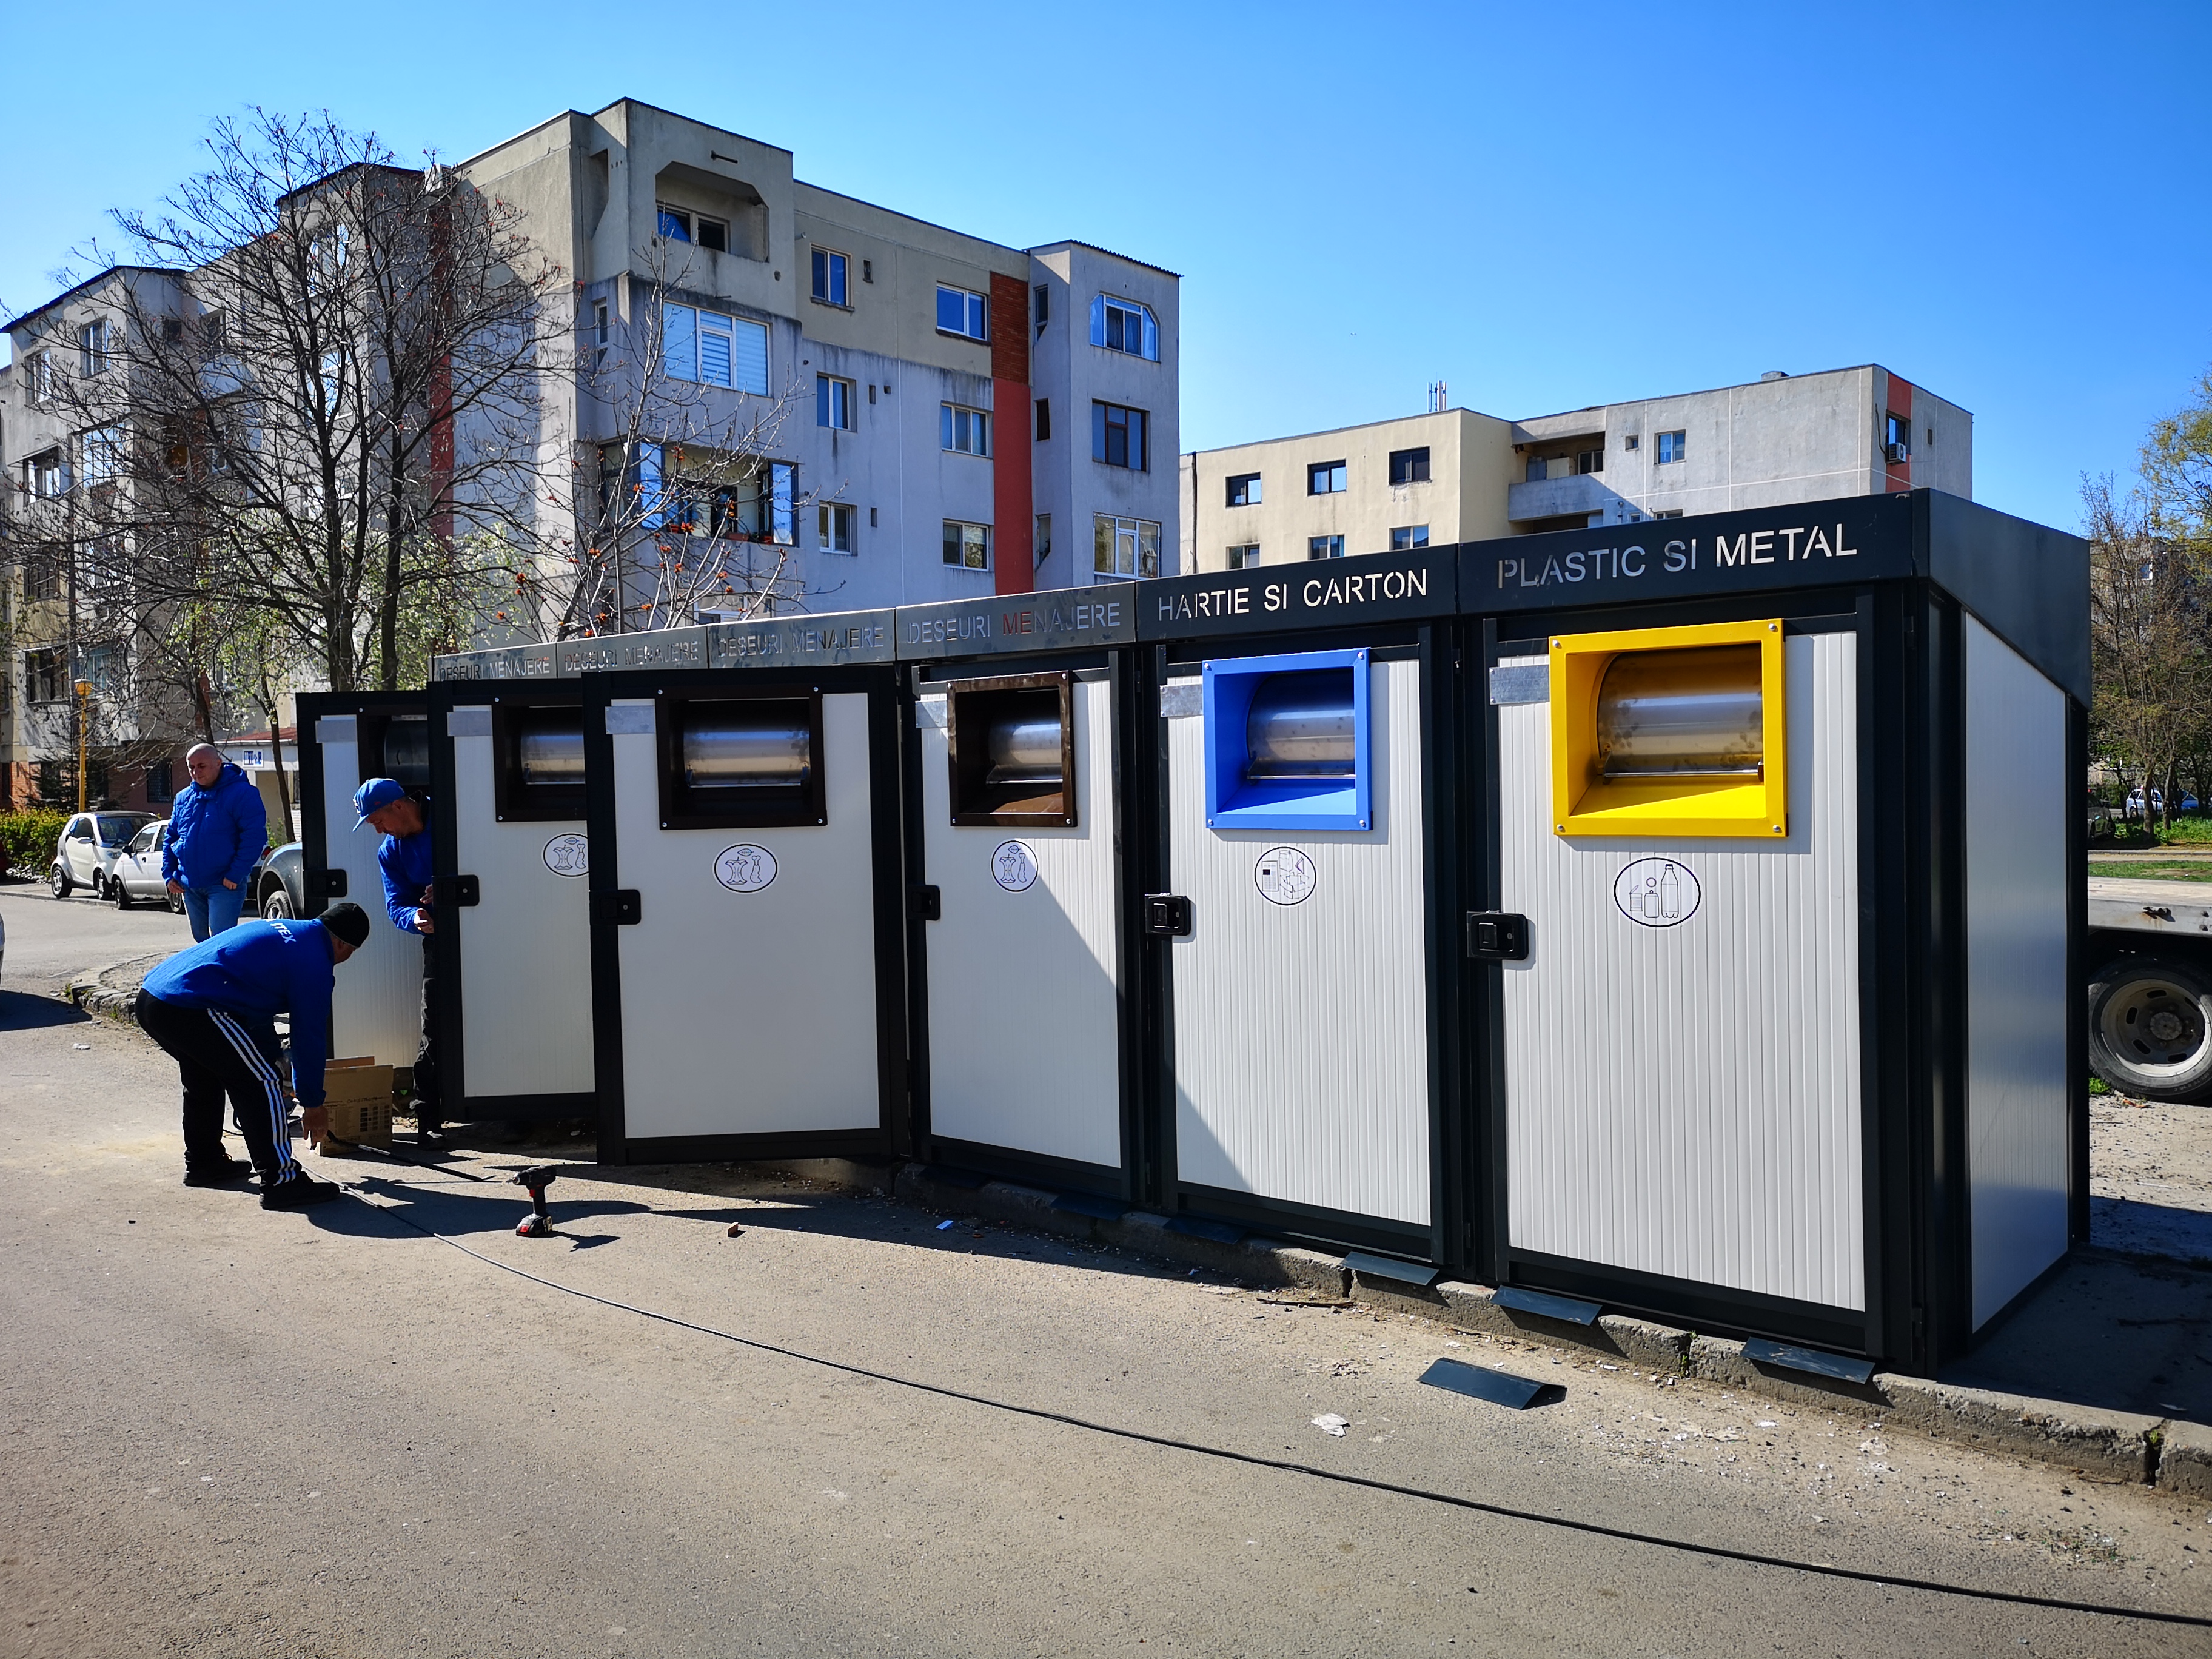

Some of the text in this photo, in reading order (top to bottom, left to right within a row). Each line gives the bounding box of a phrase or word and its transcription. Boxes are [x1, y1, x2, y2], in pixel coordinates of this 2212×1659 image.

[1498, 523, 1857, 589] PLASTIC SI METAL
[1158, 568, 1427, 622] HARTIE SI CARTON
[907, 602, 1121, 644] DESEURI MENAJERE
[564, 640, 699, 672] DESEURI MENAJERE
[718, 626, 884, 657] DESEURI MENAJERE
[439, 656, 550, 682] DESEURI MENAJERE
[270, 922, 297, 943] ITEX
